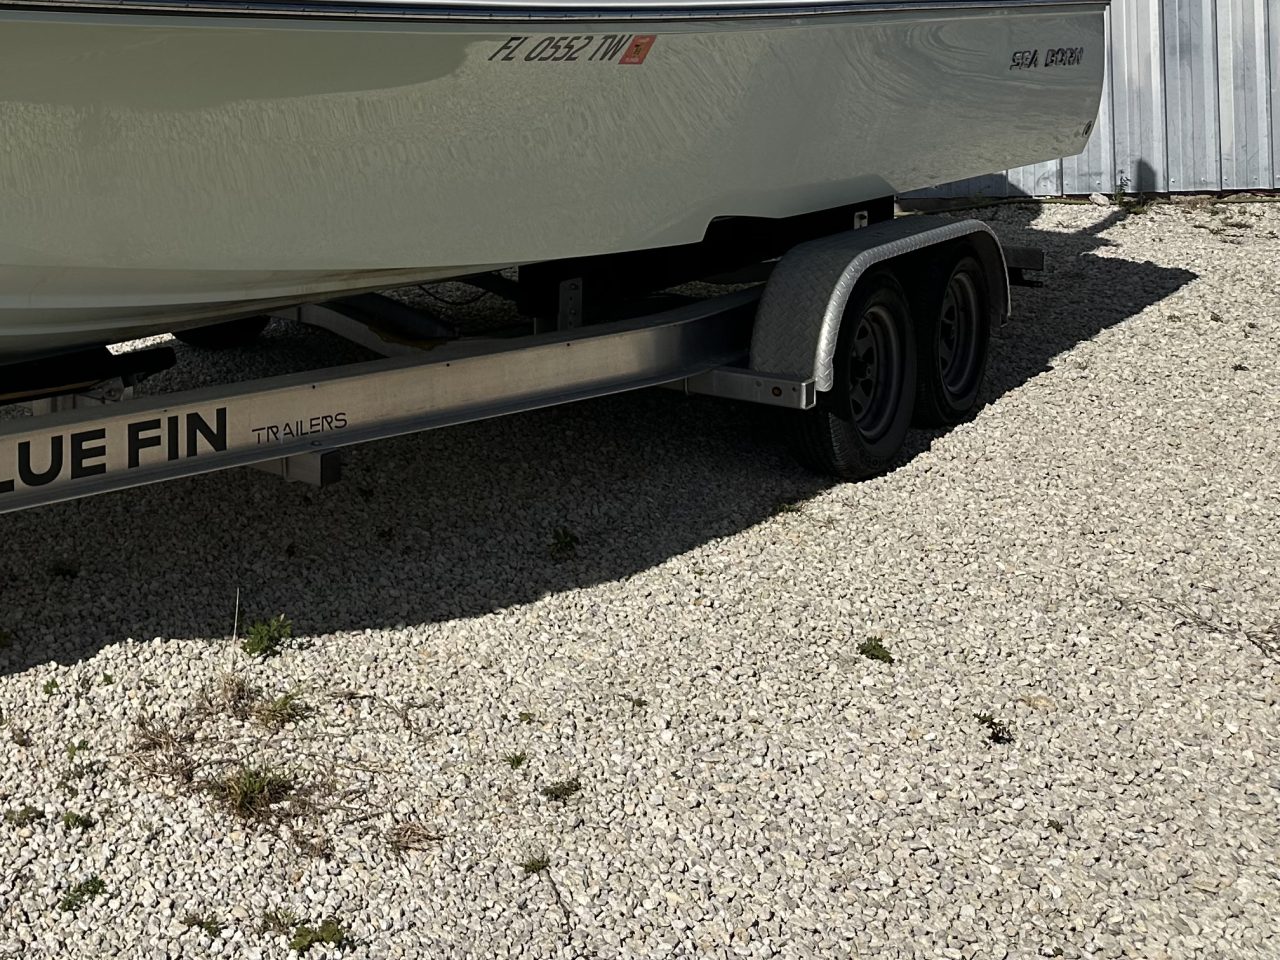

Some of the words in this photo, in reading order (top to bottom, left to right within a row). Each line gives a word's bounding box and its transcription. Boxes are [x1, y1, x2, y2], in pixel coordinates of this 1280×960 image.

[487, 36, 529, 61] FL
[523, 35, 594, 62] 0552
[587, 34, 633, 61] TW
[1009, 49, 1038, 71] SEA
[127, 407, 227, 469] FIN
[251, 412, 348, 445] TRAILERS
